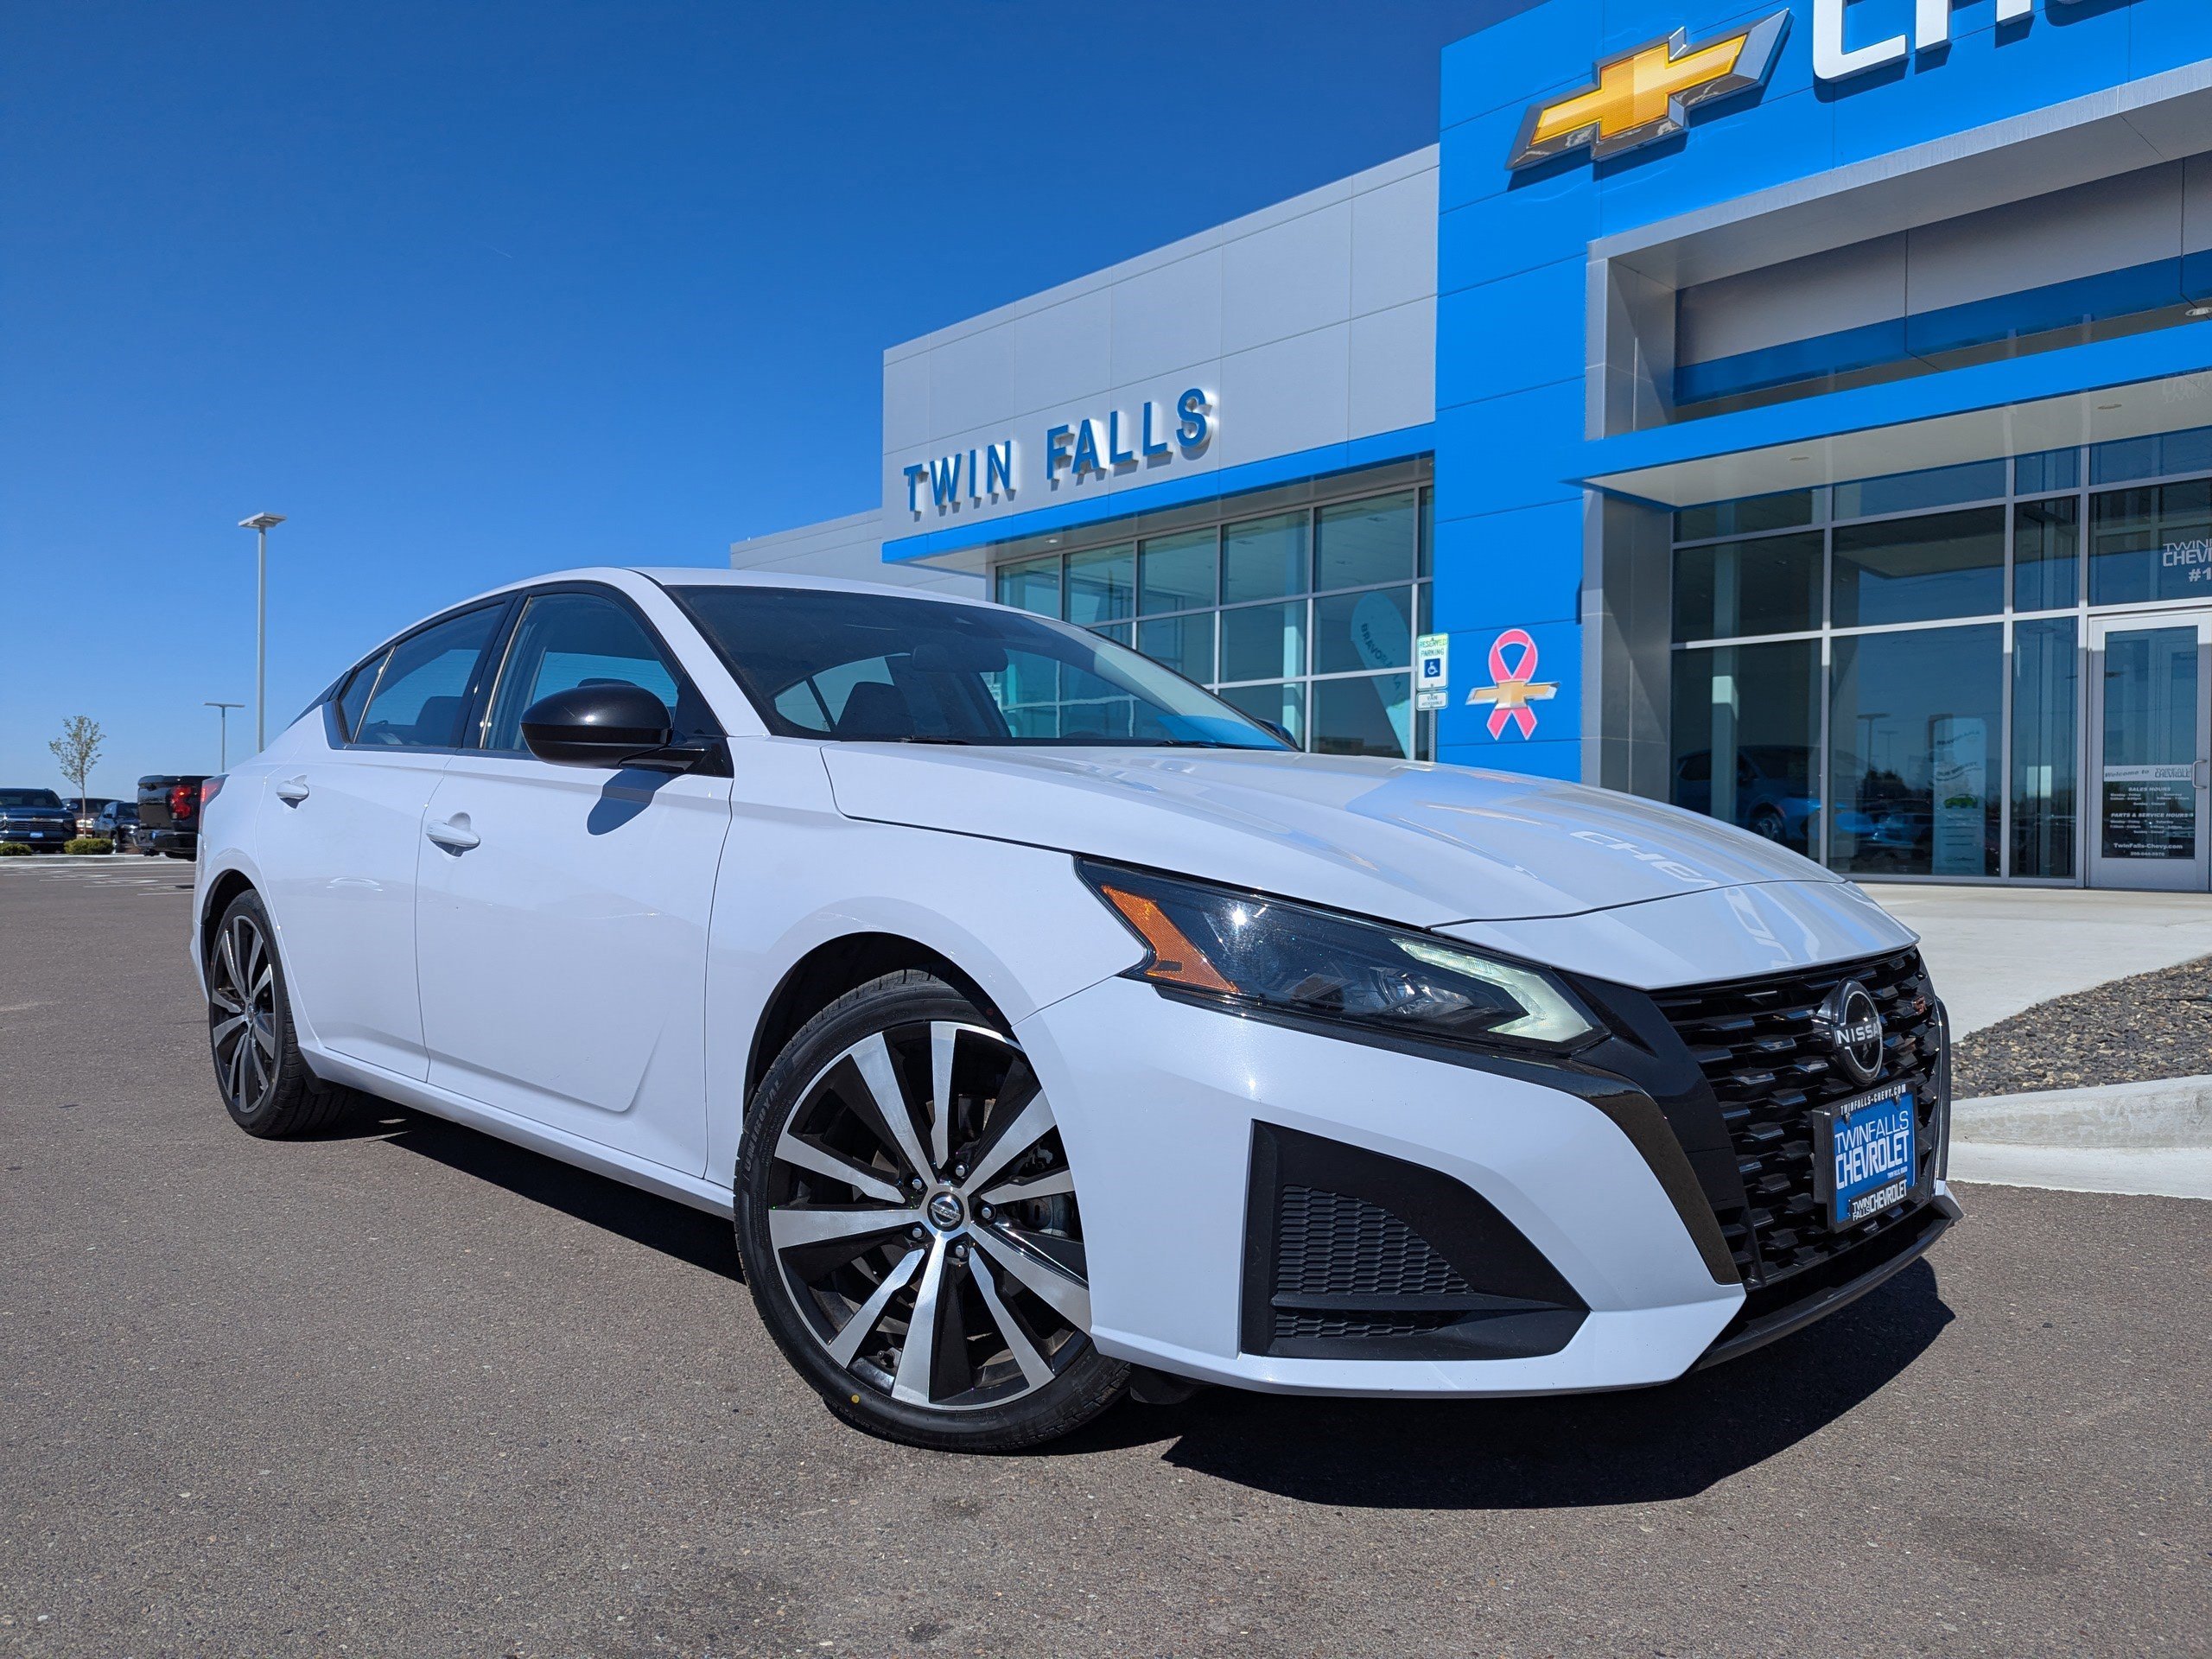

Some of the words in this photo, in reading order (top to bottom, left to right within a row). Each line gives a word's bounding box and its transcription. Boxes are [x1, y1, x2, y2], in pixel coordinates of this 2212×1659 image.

[903, 440, 1014, 512] TWIN
[1046, 387, 1208, 480] FALLS
[1419, 639, 1447, 648] RESERVED
[1421, 648, 1445, 657] PARKING
[1840, 1083, 1906, 1116] TWINFALLS-CHEVY.COM
[1834, 1110, 1910, 1154] TWINFALLS
[1835, 1129, 1910, 1191] CHEVROLET
[1852, 1196, 1870, 1213] TWIN
[1869, 1179, 1908, 1213] CHEVROLET
[1853, 1205, 1871, 1222] FALLS
